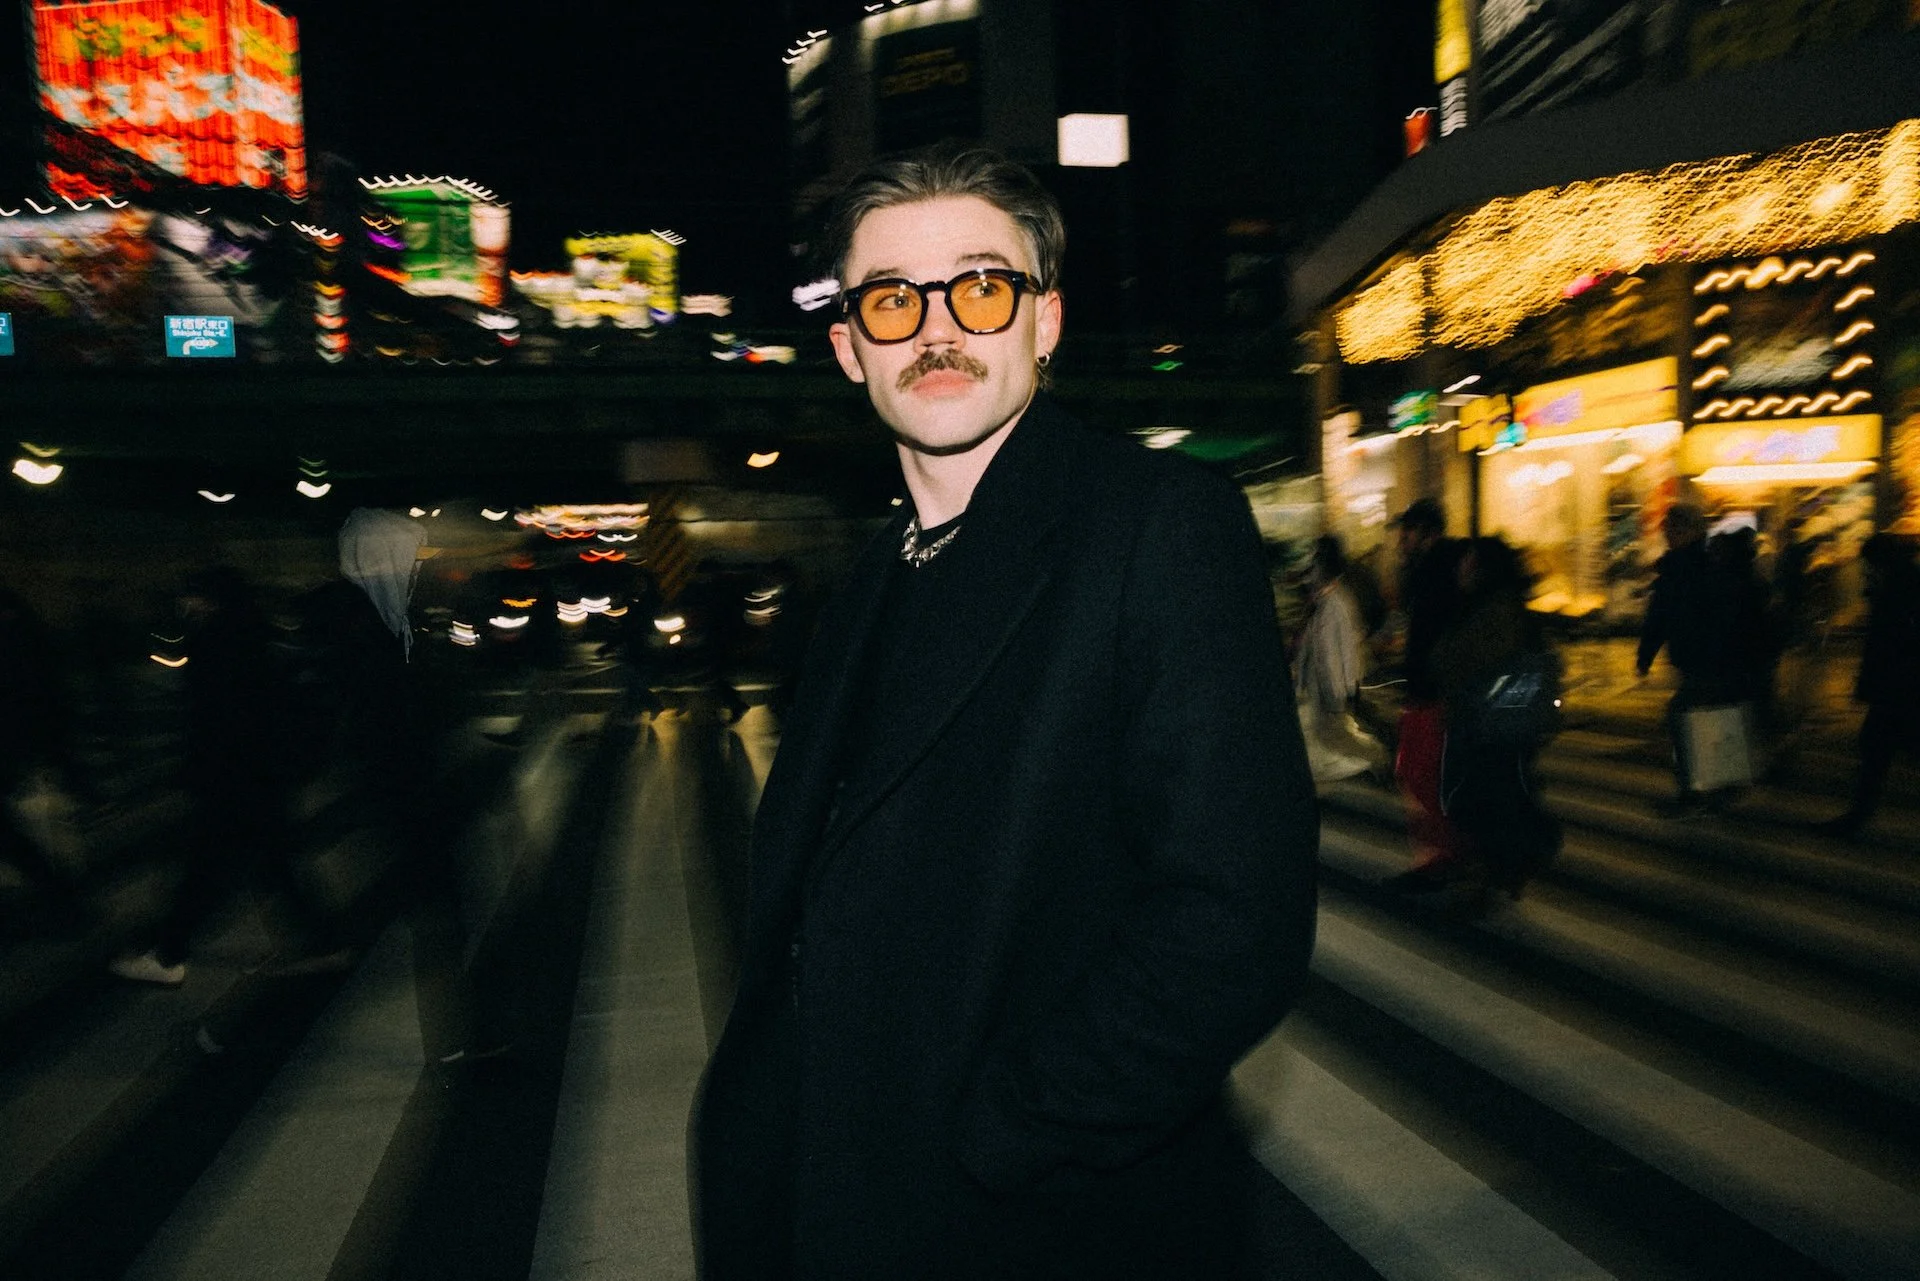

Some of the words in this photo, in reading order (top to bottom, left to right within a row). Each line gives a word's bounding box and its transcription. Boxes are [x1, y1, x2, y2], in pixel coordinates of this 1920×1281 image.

[170, 318, 228, 330] 新宿駅東口
